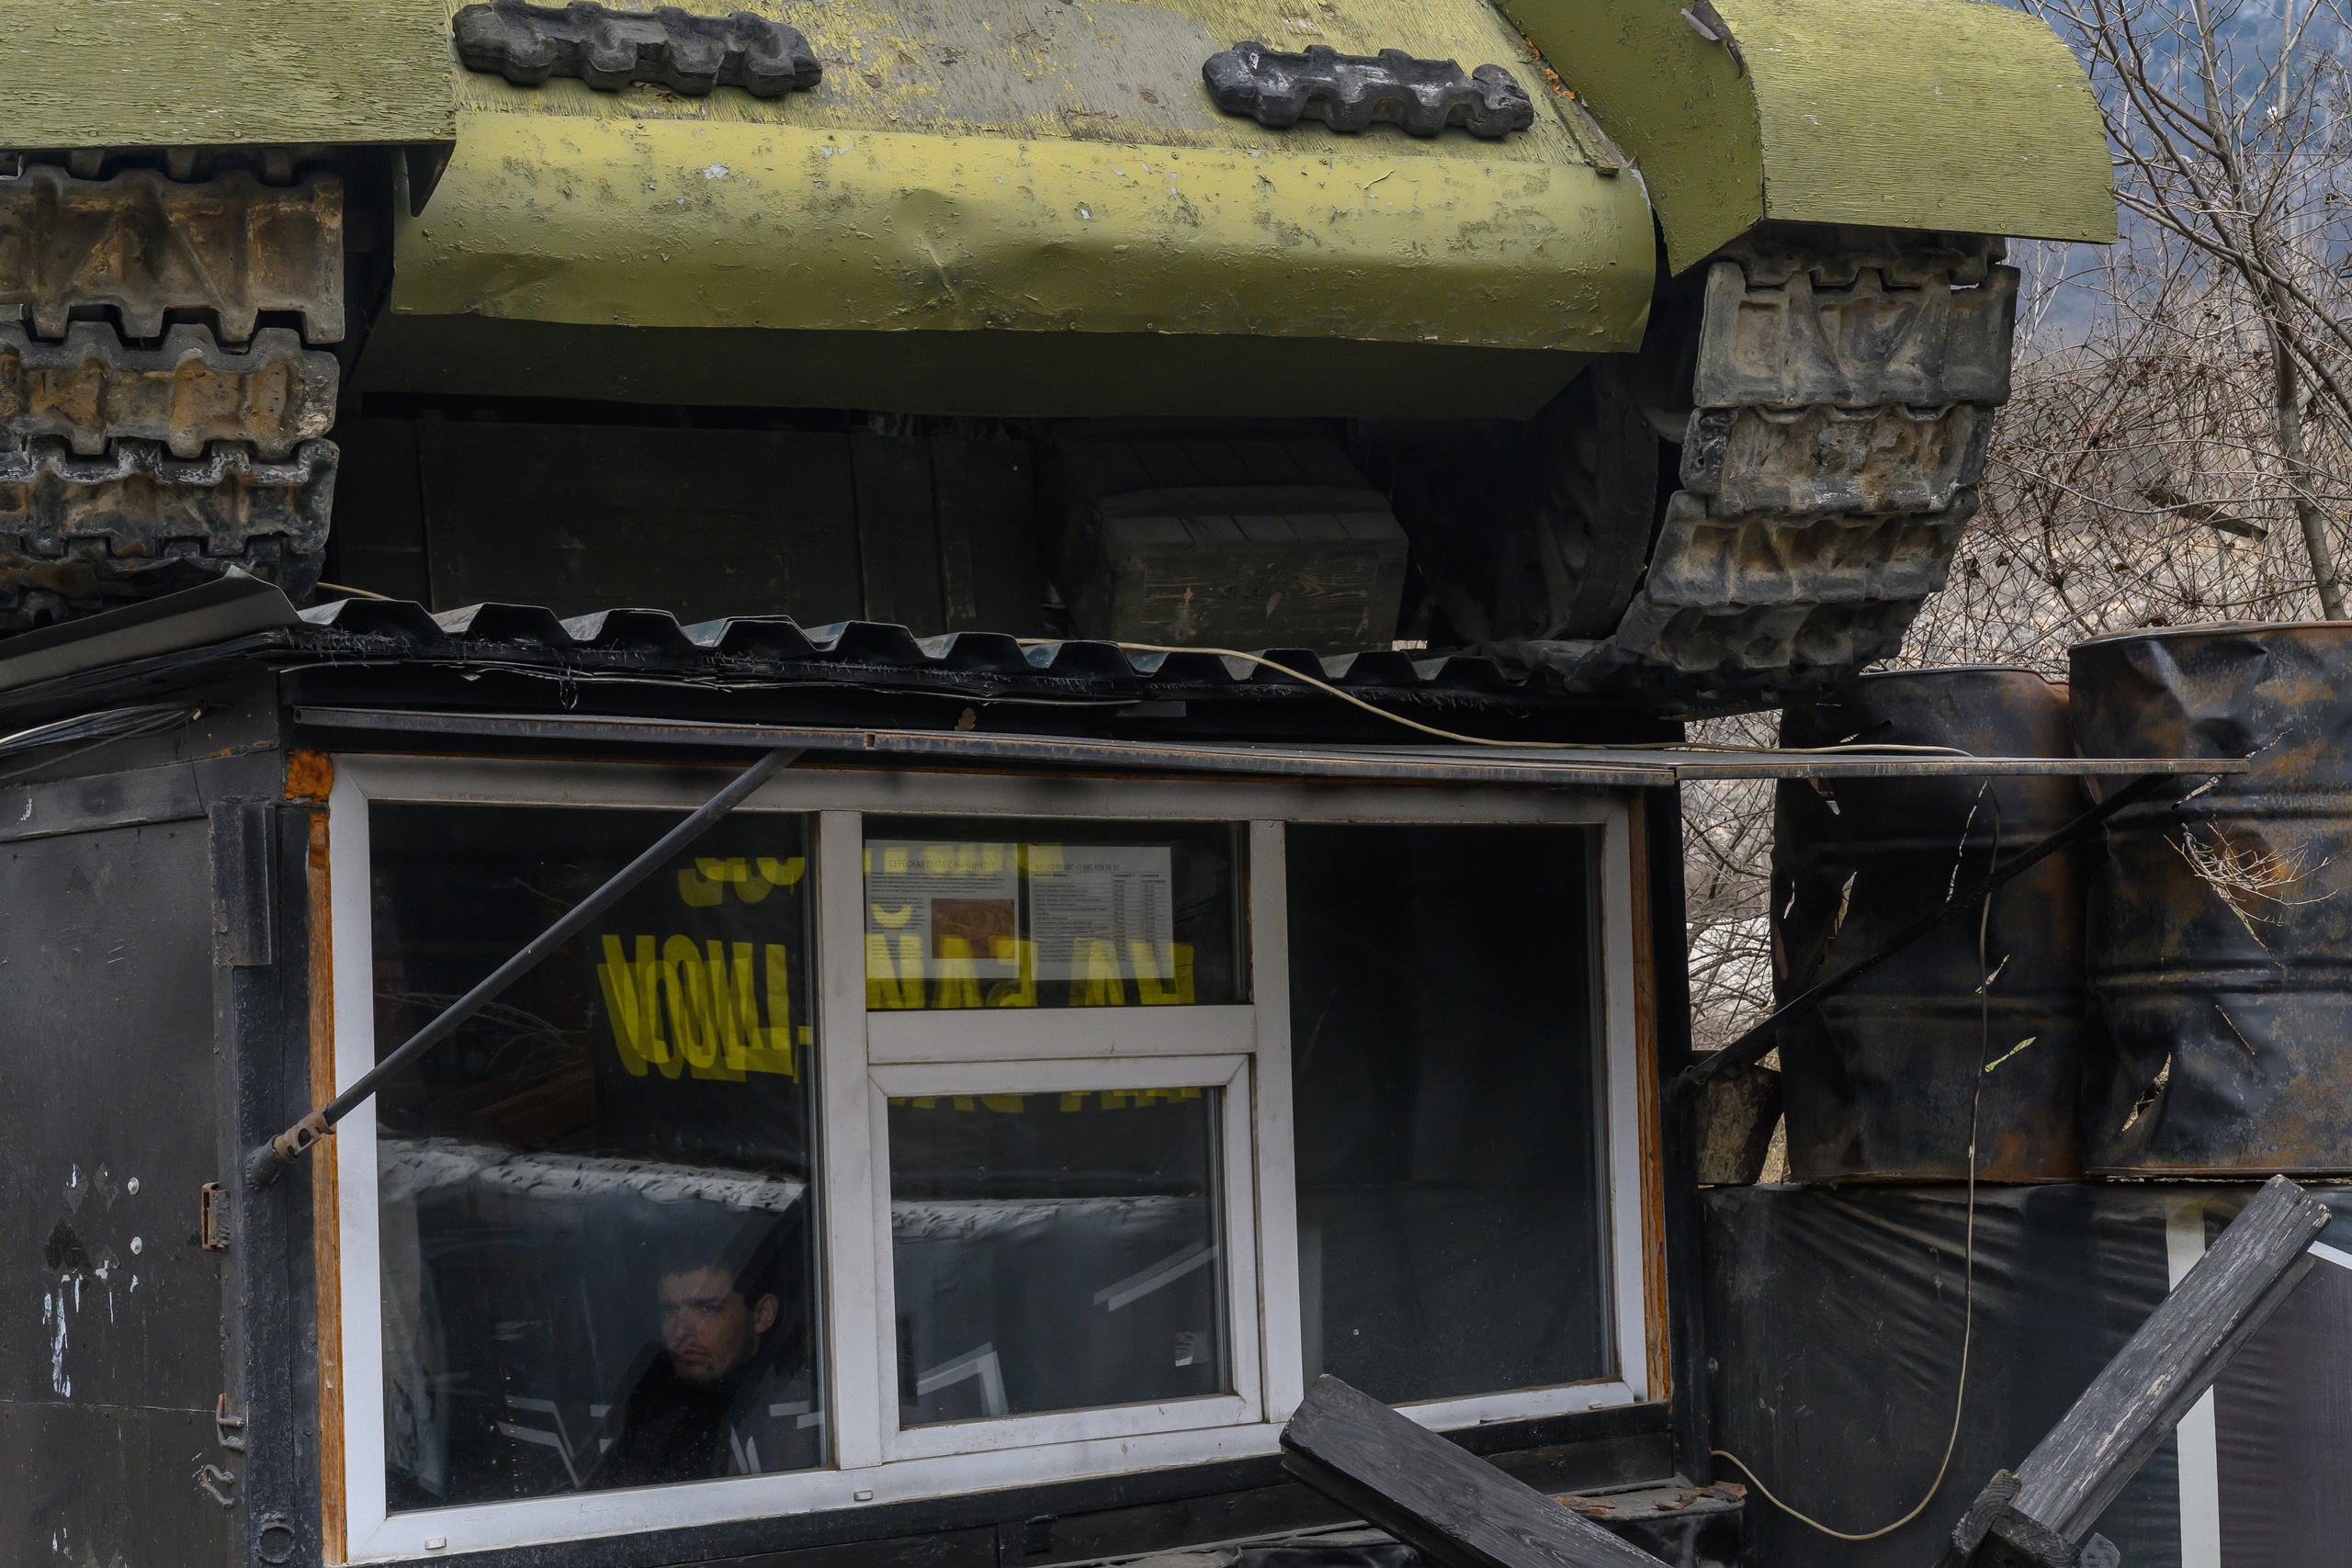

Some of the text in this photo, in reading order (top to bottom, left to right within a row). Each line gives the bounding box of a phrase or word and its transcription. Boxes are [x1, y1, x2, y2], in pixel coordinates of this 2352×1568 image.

[888, 859, 994, 870] СЕРБСКАЯ ПИТА С НАЧИНКОЙ
[1035, 863, 1054, 872] МЕНЮ
[1075, 863, 1082, 872] +7
[1083, 863, 1093, 872] 985
[1105, 863, 1113, 872] 76
[1114, 863, 1121, 872] 37
